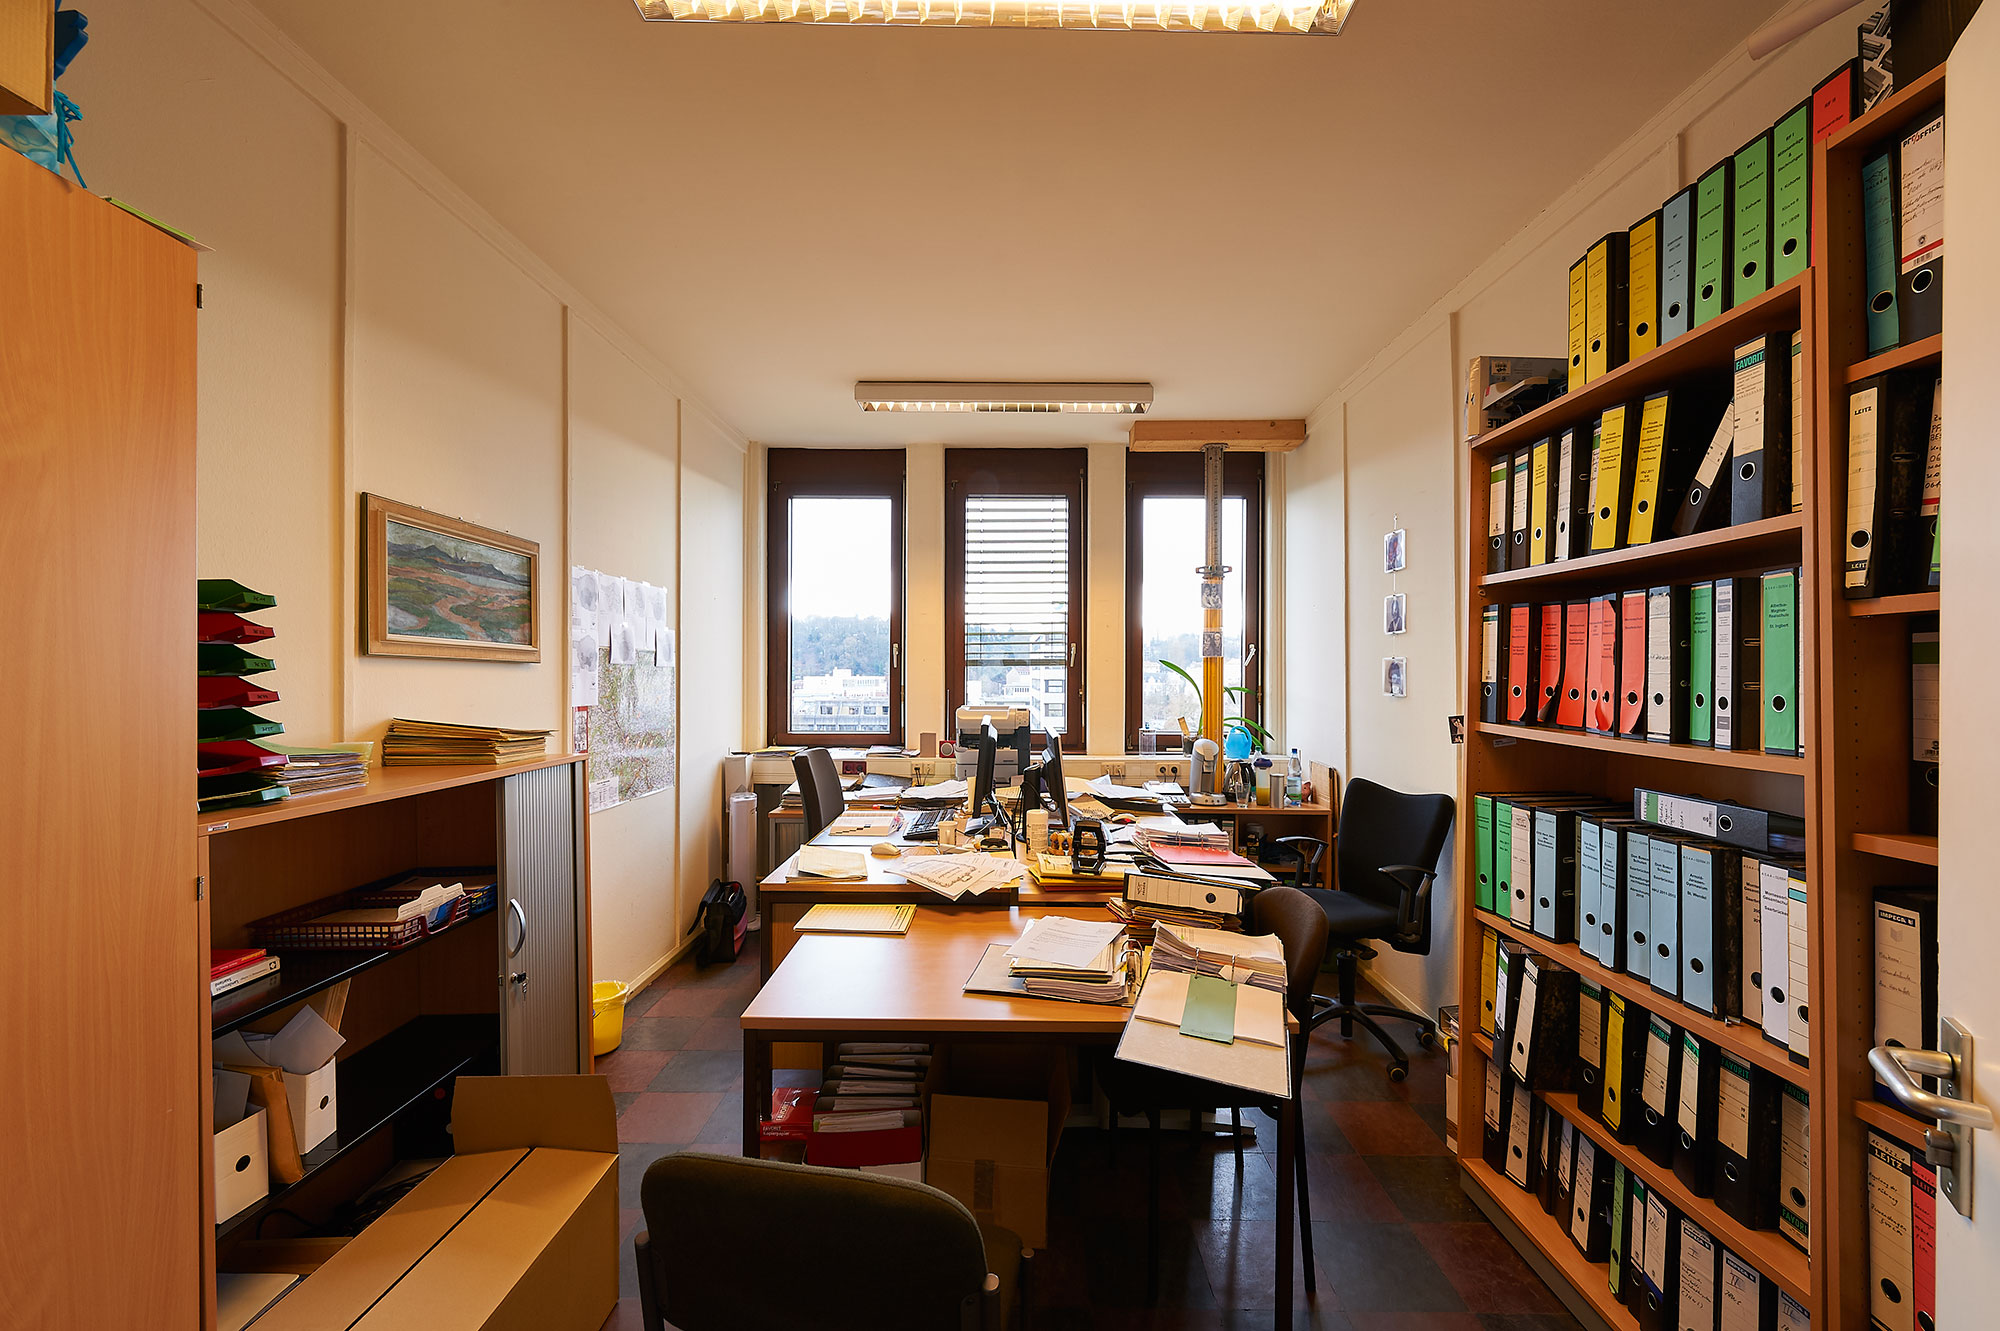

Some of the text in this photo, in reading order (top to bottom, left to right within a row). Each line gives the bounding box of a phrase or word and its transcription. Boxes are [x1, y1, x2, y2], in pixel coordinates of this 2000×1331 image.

[1736, 351, 1764, 371] FAVORIT
[1854, 406, 1872, 415] LEITZ
[1654, 875, 1675, 883] Saarbrücken
[1686, 882, 1708, 891] Gymnasium
[1650, 1024, 1669, 1042] FAVORIT
[1721, 1057, 1749, 1079] FAVORIT
[776, 1102, 790, 1121] FAVORIT
[1875, 1149, 1903, 1171] LEITZ
[1916, 1179, 1935, 1195] LEITZ
[1782, 1209, 1808, 1234] FAVORI
